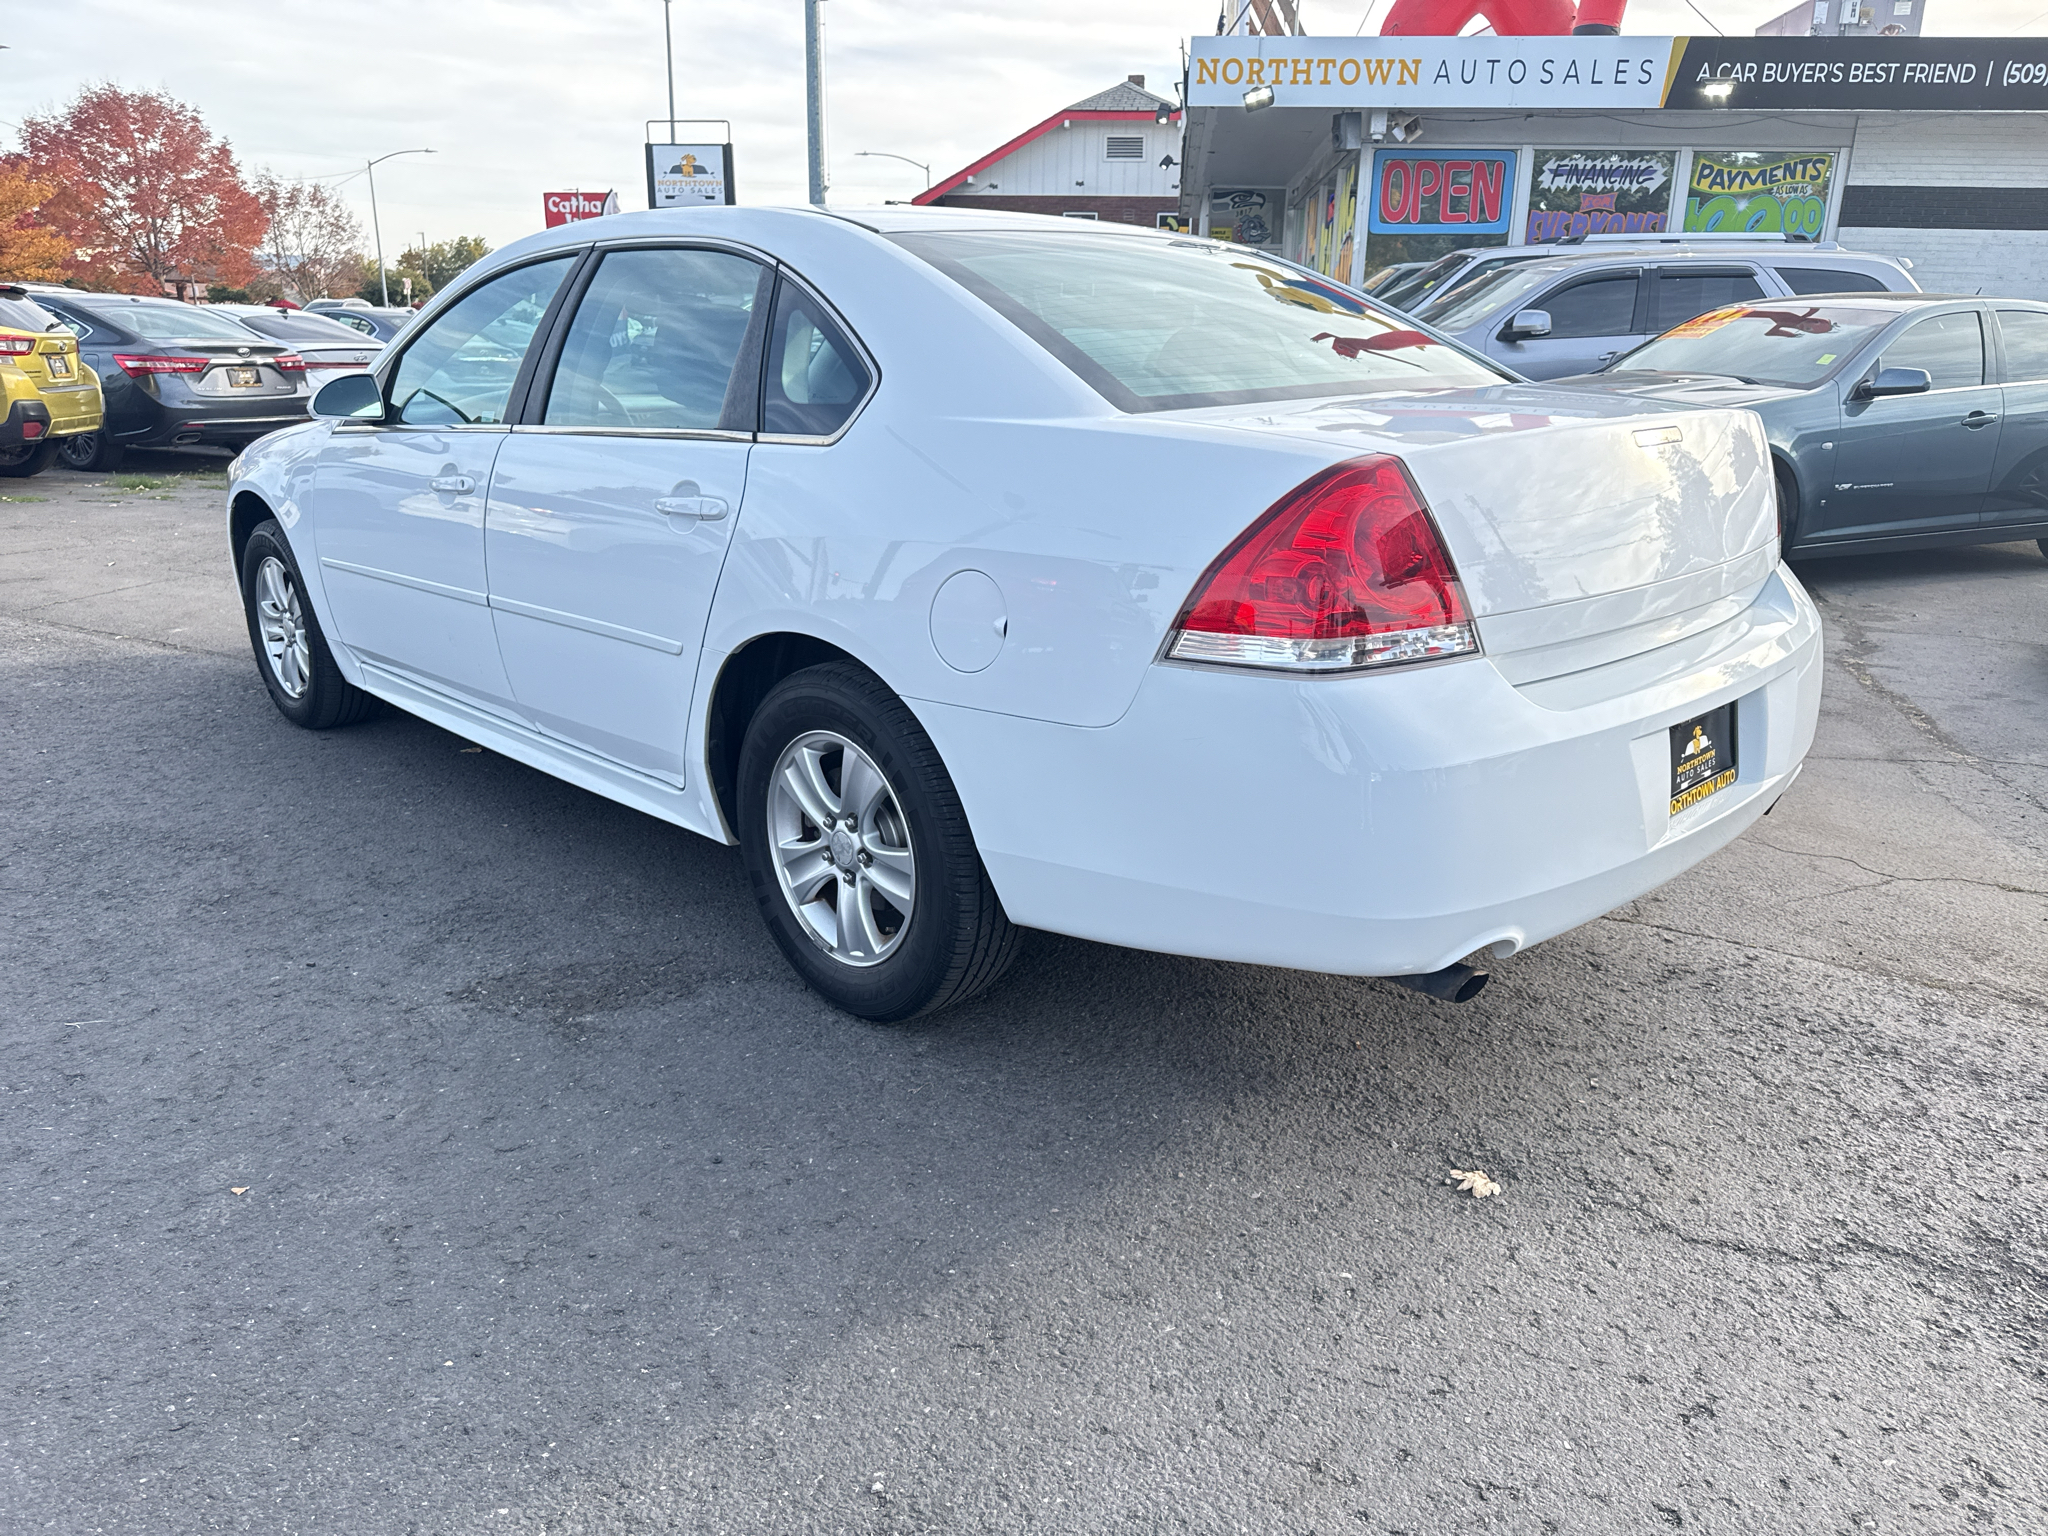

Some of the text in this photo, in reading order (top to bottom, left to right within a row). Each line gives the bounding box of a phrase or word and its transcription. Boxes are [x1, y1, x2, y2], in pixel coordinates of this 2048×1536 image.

[1196, 58, 1654, 85] NORTHTOWN AUTO SALES
[1695, 62, 1711, 82] A
[1716, 62, 1758, 83] CAR
[1762, 62, 1844, 83] BUYER'S
[1848, 63, 1901, 83] BEST
[1903, 63, 1977, 83] FRIEND
[1550, 163, 1655, 185] FINANCING
[1696, 157, 1827, 190] PAYMENTS
[1380, 160, 1504, 223] OPEN
[1583, 196, 1611, 207] FOR
[1775, 184, 1808, 195] AS LOW AS
[548, 195, 603, 213] Catha
[1676, 757, 1716, 784] AUTO SALES
[1677, 749, 1716, 775] NORTHTOWN
[1669, 769, 1736, 816] ORTHTOWN AUTO
